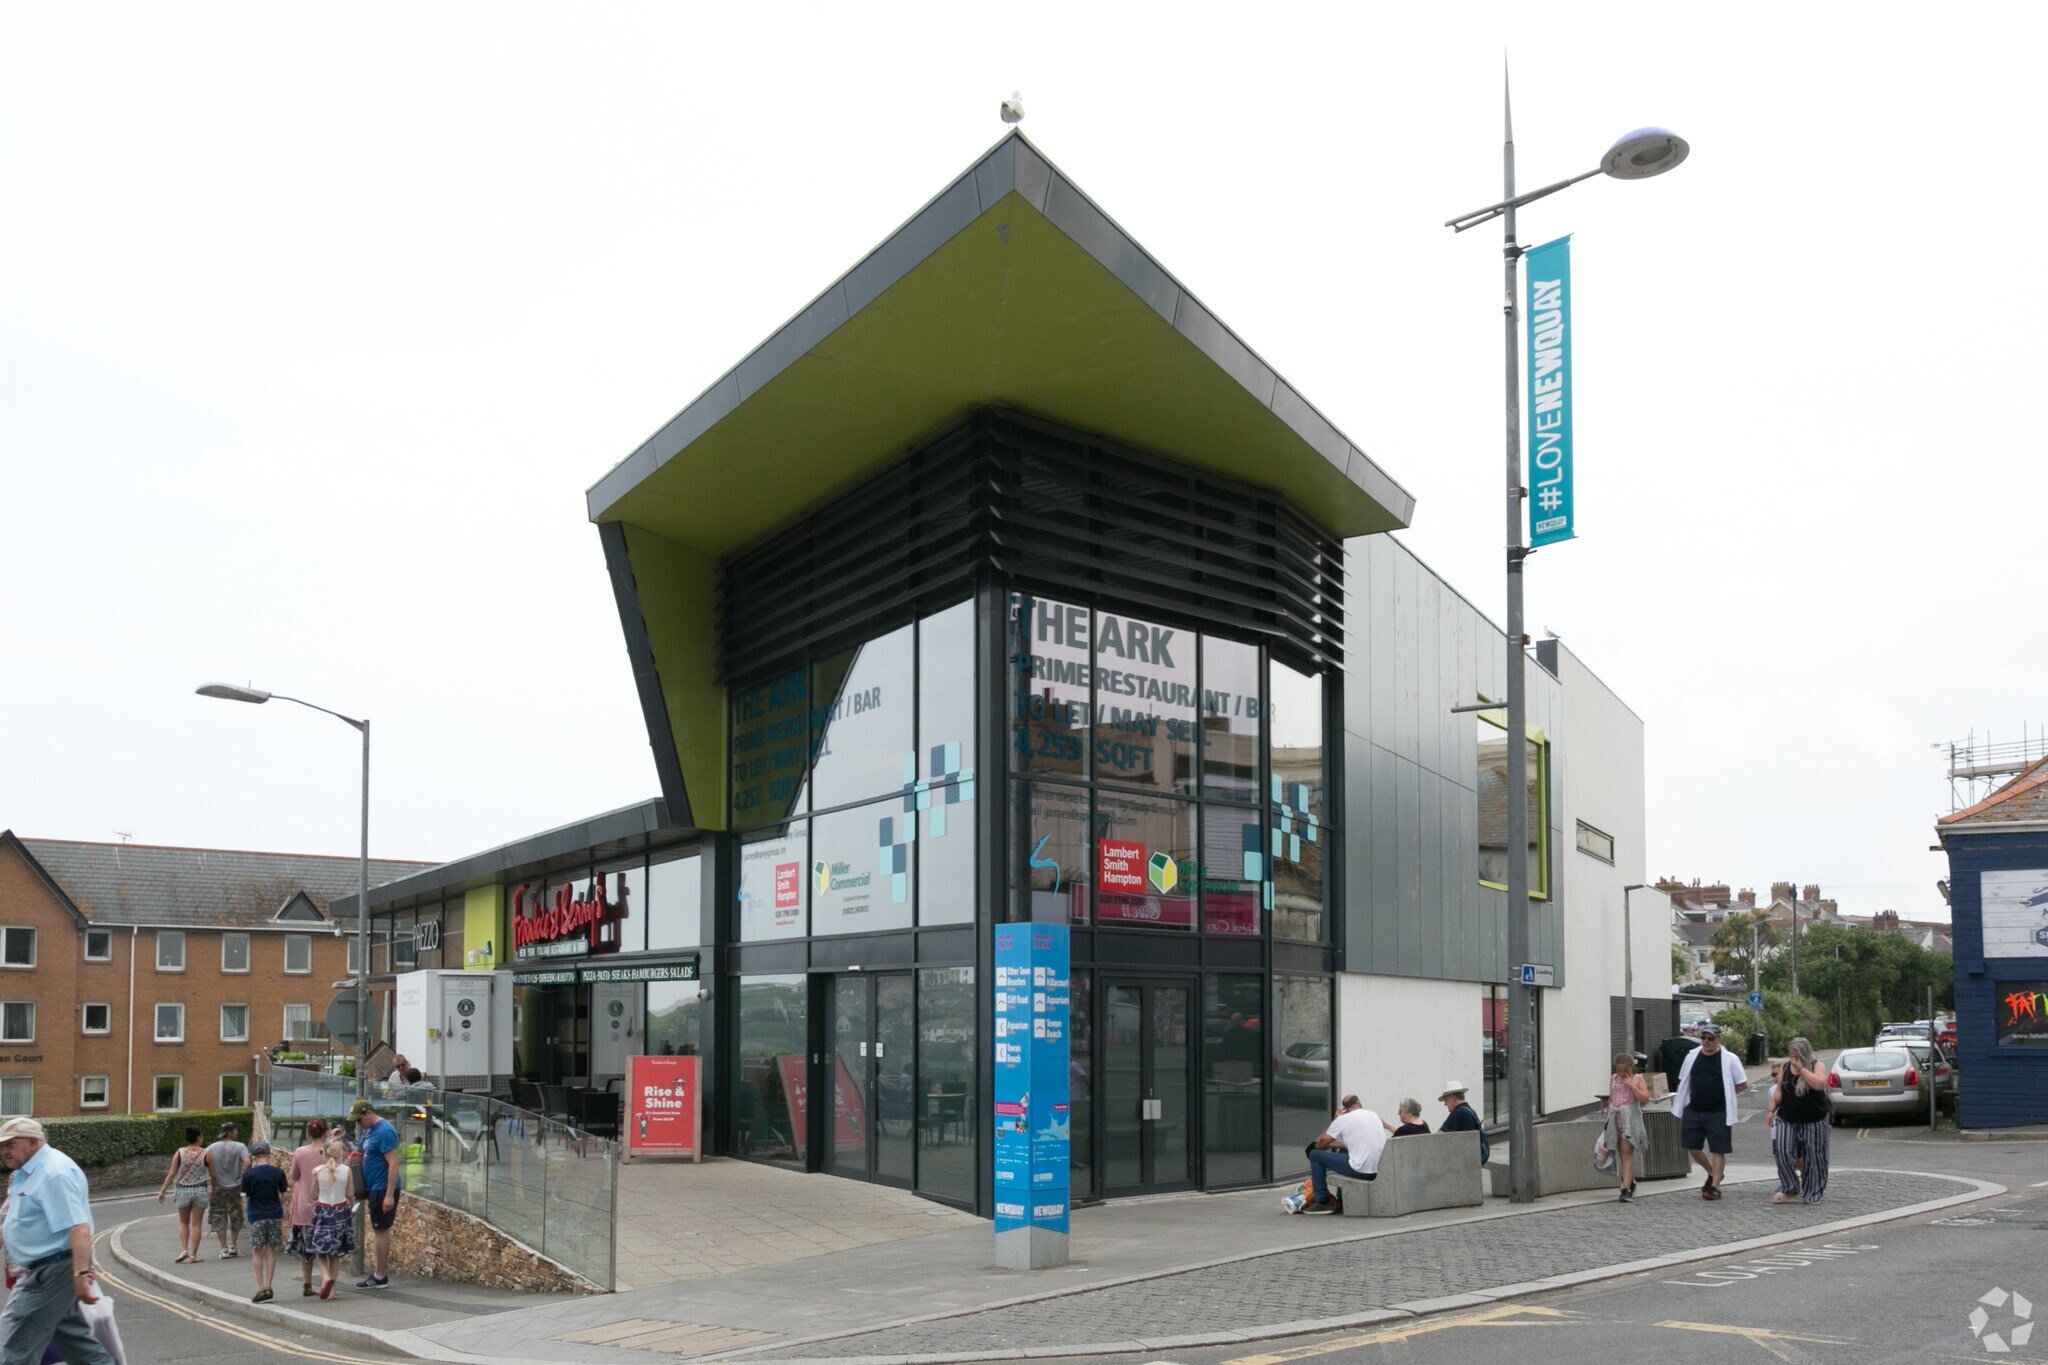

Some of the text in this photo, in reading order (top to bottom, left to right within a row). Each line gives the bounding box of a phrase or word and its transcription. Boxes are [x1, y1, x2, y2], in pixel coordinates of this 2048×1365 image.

[1533, 278, 1564, 511] #LOVENEWQUAY
[1537, 517, 1565, 530] NEWQUAY
[1011, 592, 1176, 669] THE ARK
[769, 665, 808, 713] ARK
[1015, 651, 1090, 689] PRIME
[1096, 666, 1231, 714] RESTAURANT
[1234, 694, 1242, 716] /
[853, 686, 882, 715] BAR
[1014, 690, 1046, 721] TO
[1053, 697, 1091, 726] LET
[1110, 706, 1162, 737] MAY
[1166, 716, 1212, 747] SELL
[1015, 728, 1154, 772] 4,253 SQFT
[1103, 845, 1140, 860] Lambert
[831, 861, 850, 876] Miller
[1103, 859, 1129, 872] Smith
[777, 869, 796, 880] Lambert
[830, 871, 871, 891] Commercial
[1103, 872, 1142, 886] Hampton
[777, 879, 790, 890] Smith
[777, 890, 797, 902] Hampton
[412, 919, 439, 952] PREZZO
[1047, 967, 1056, 976] The
[1007, 977, 1026, 986] Beaches
[1047, 996, 1070, 1006] Aquarium
[1007, 1021, 1028, 1031] Aquarium
[1047, 1019, 1062, 1028] Towan
[1047, 1028, 1062, 1038] Beach
[14, 1054, 44, 1063] Court
[1007, 1053, 1021, 1063] Beach
[644, 1086, 685, 1097] Rise &
[645, 1098, 682, 1109] Shine
[996, 1203, 1025, 1216] NEWQUAY
[1034, 1204, 1064, 1217] NEWQUAY
[1662, 1242, 1880, 1287] LOADING
